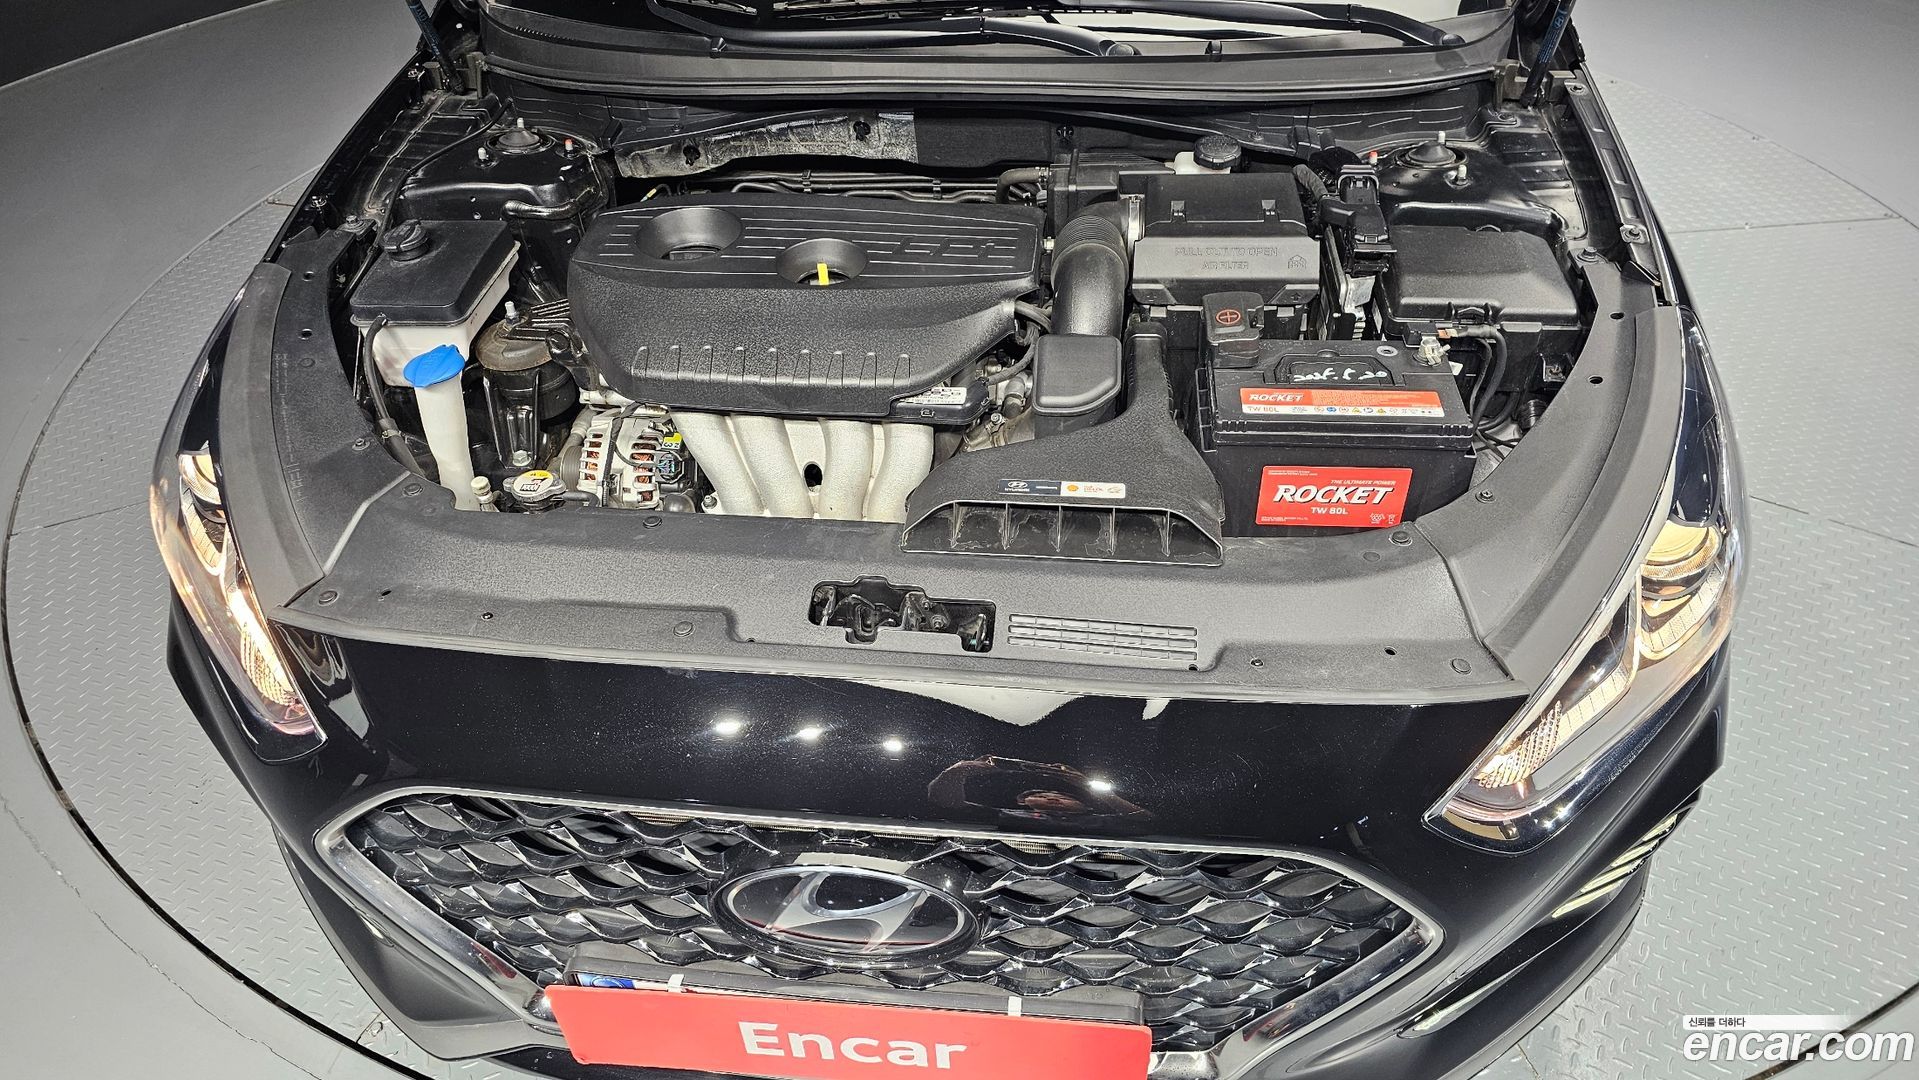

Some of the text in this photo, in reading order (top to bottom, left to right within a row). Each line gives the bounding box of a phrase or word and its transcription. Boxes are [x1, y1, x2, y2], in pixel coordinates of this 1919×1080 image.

[1175, 247, 1279, 256] PULL OUT TO OPEN
[1201, 261, 1249, 270] AIR FILTER
[1249, 393, 1304, 402] ROCKET
[1273, 484, 1395, 504] ROCKET
[1311, 507, 1348, 515] TW 80L
[737, 1021, 968, 1069] Encar
